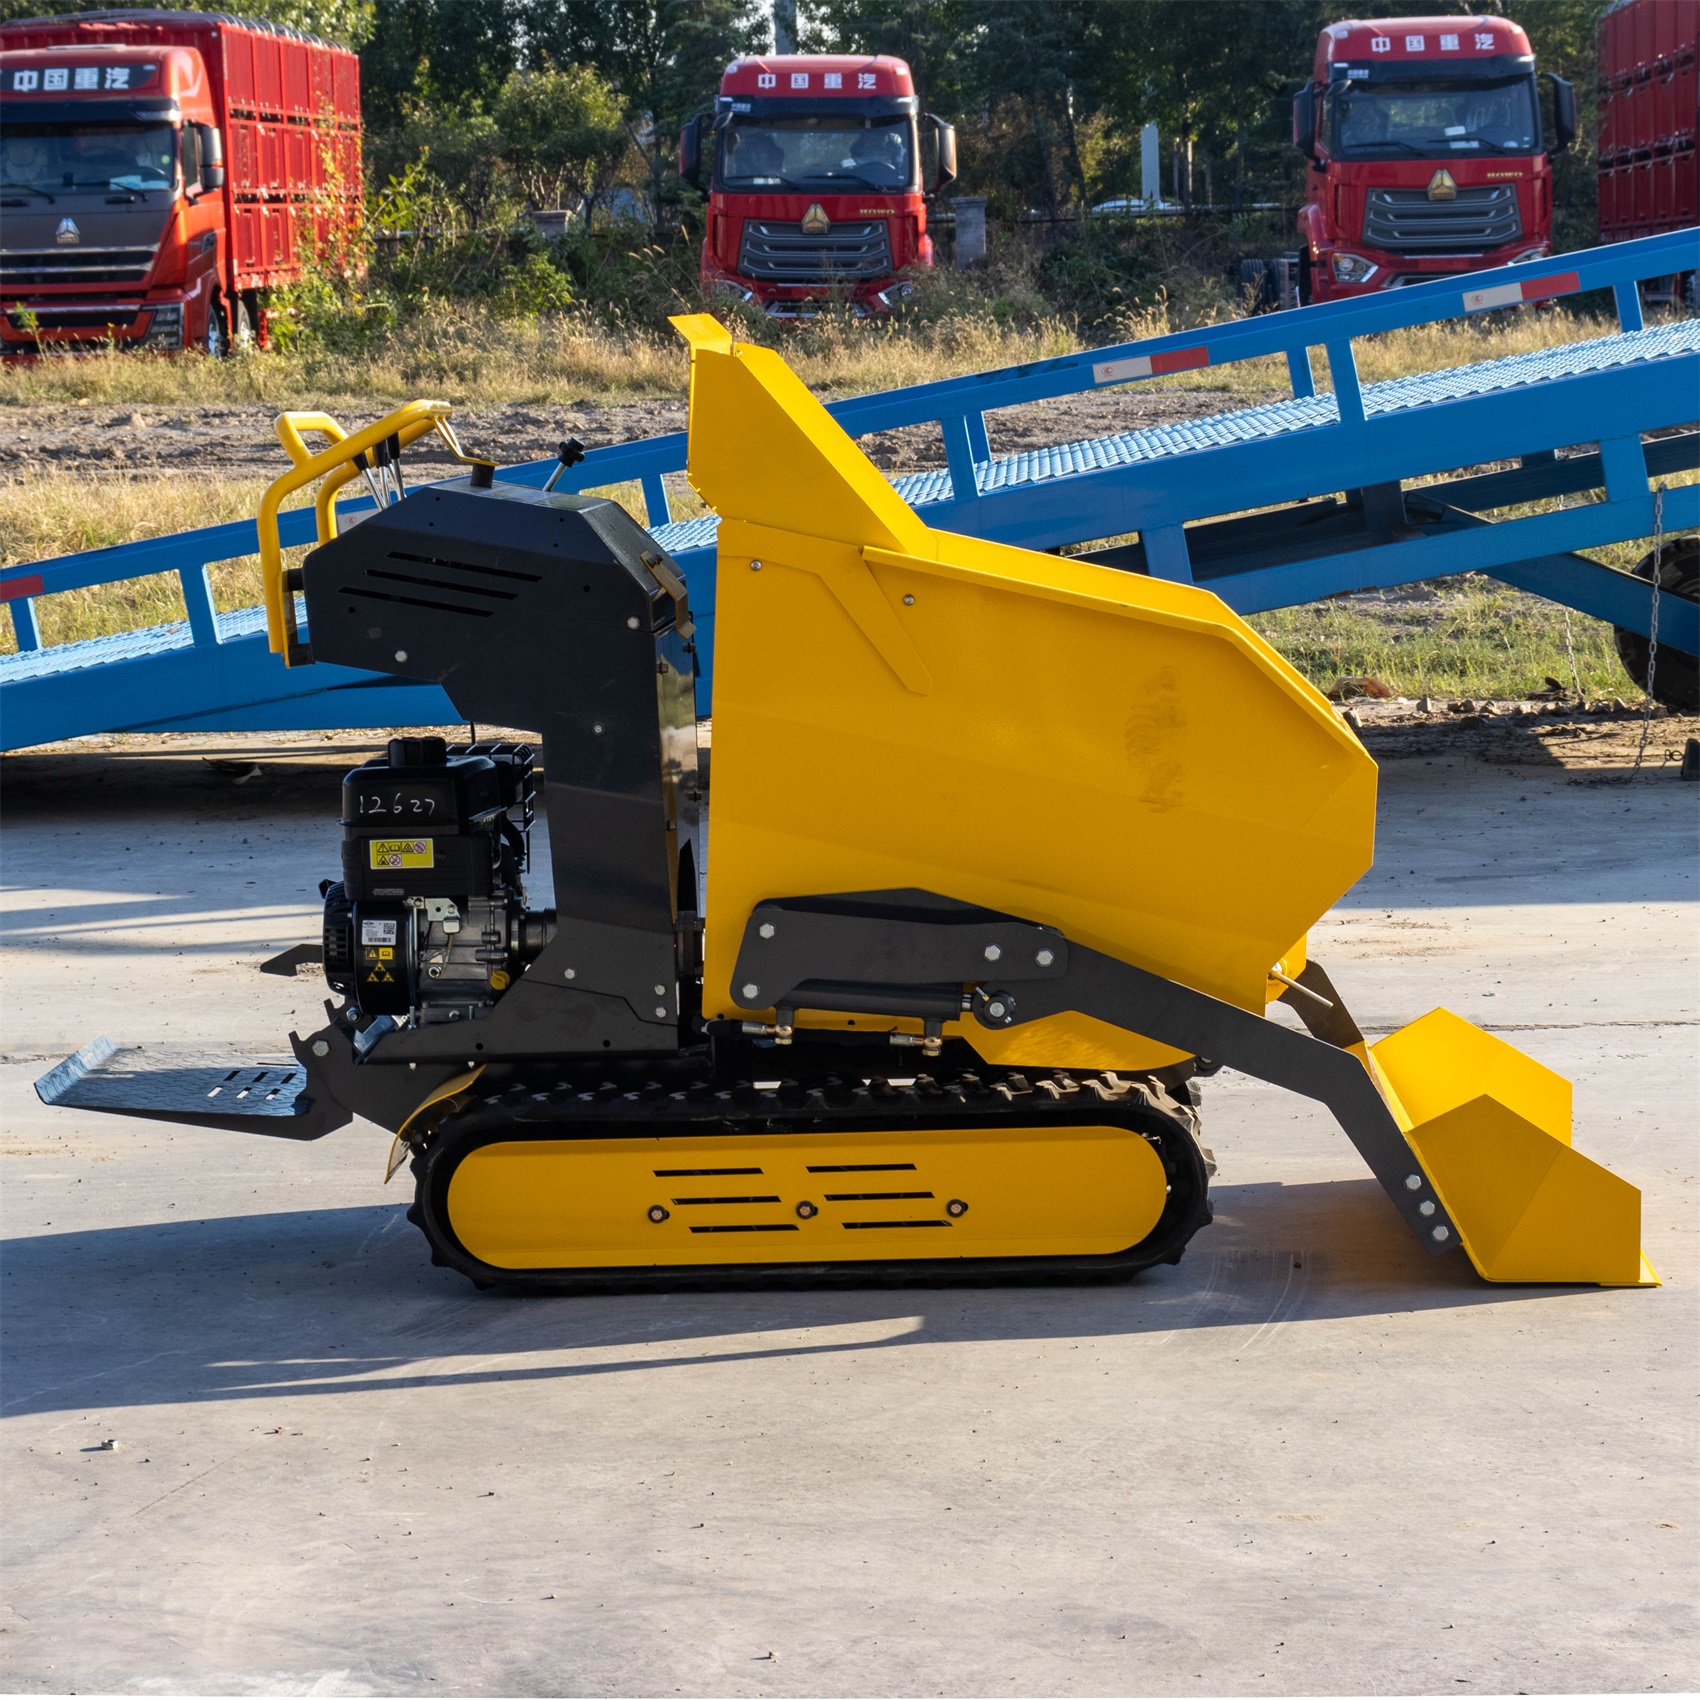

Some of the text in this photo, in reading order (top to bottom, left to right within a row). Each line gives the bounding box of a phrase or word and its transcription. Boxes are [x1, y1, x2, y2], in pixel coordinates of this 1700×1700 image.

[1371, 33, 1495, 53] 中国重汽
[13, 67, 130, 92] 中国重汽
[758, 72, 877, 89] 中国重汽
[360, 793, 435, 816] 12627
